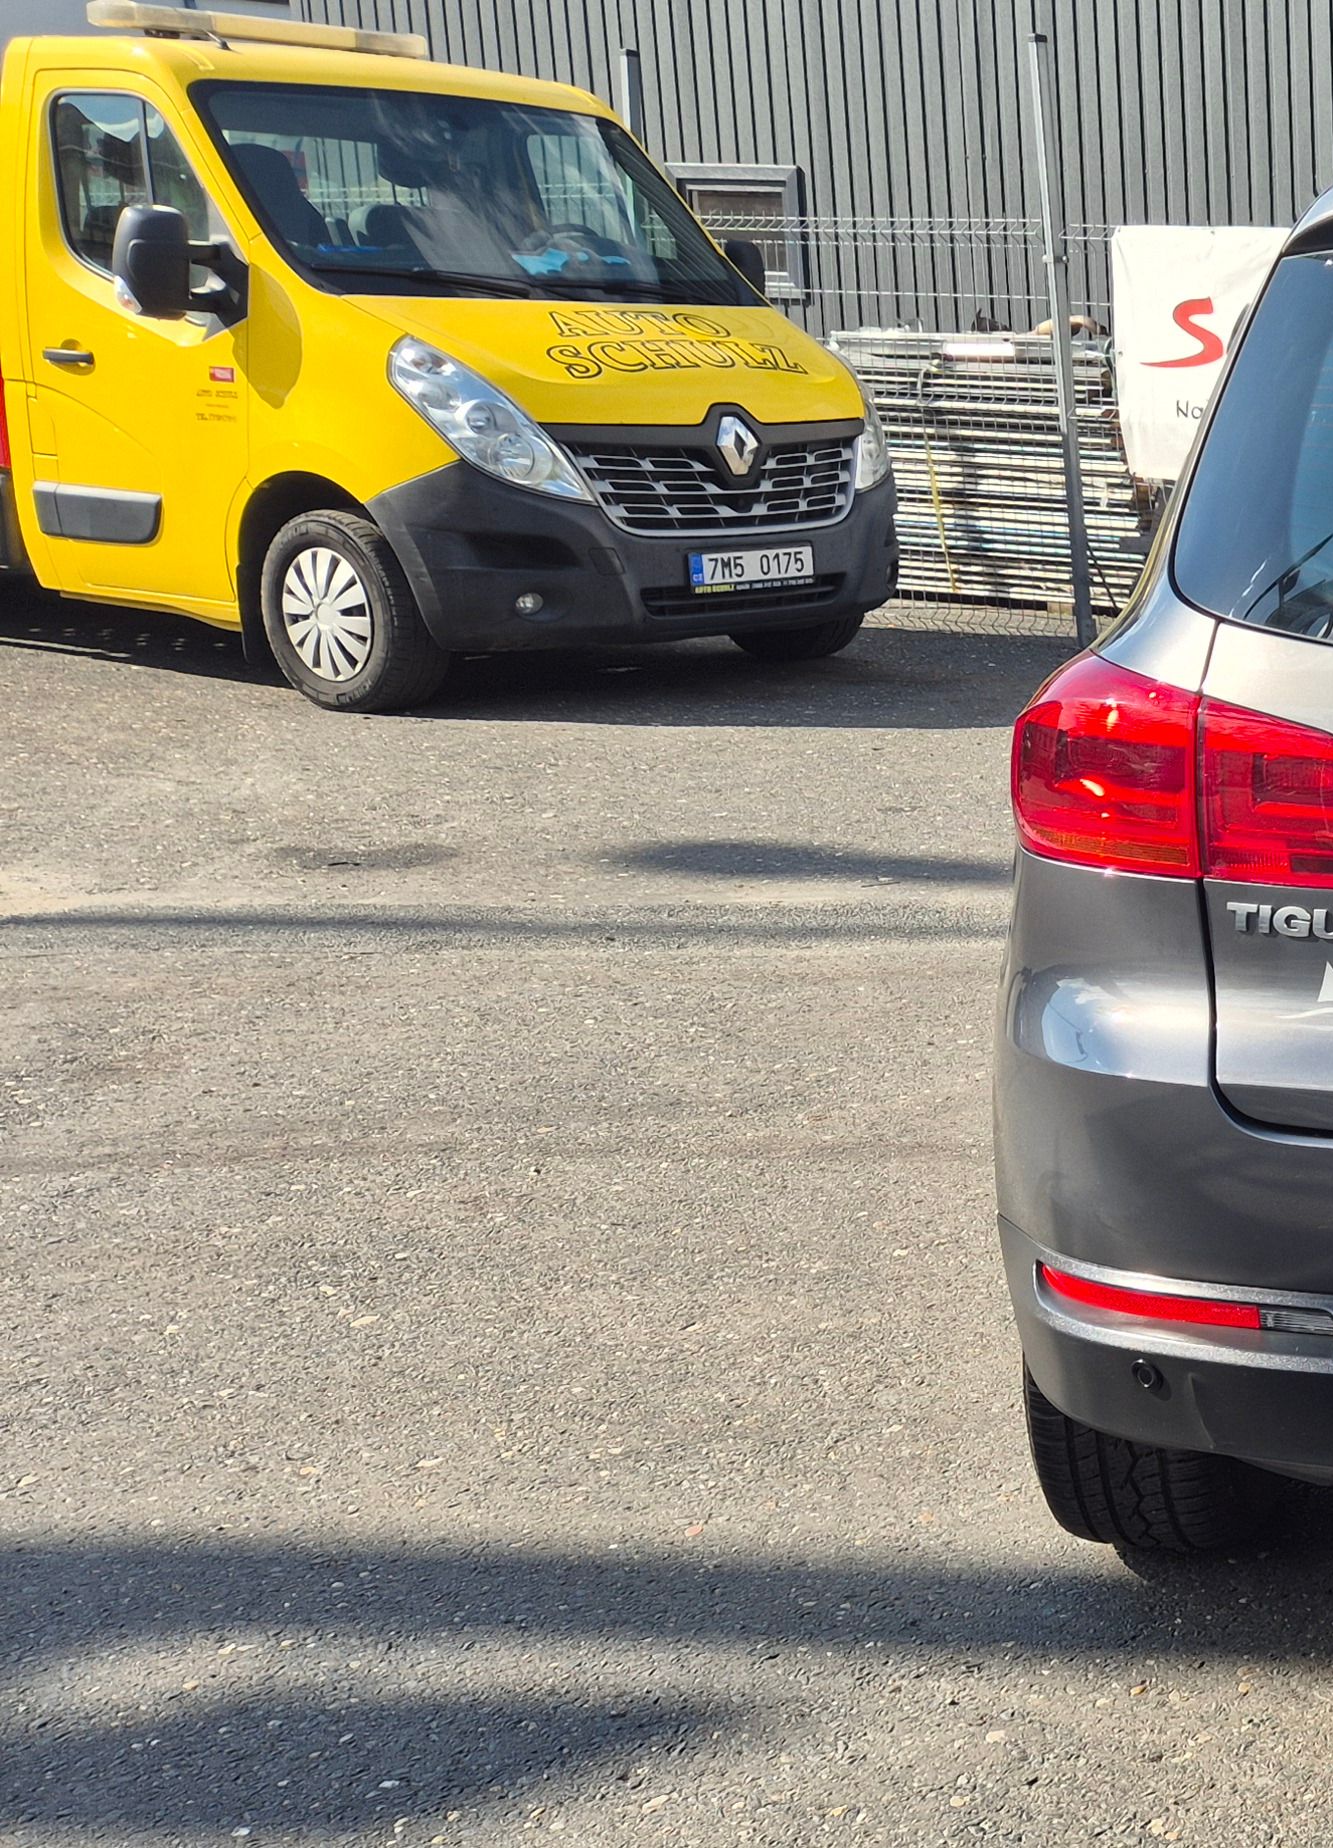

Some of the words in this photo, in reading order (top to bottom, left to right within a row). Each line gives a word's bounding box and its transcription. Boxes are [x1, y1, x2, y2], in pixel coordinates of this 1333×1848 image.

[550, 311, 731, 338] AUTO
[546, 340, 809, 379] SCHULZ
[708, 556, 745, 580] 7M5
[760, 551, 804, 576] 0175
